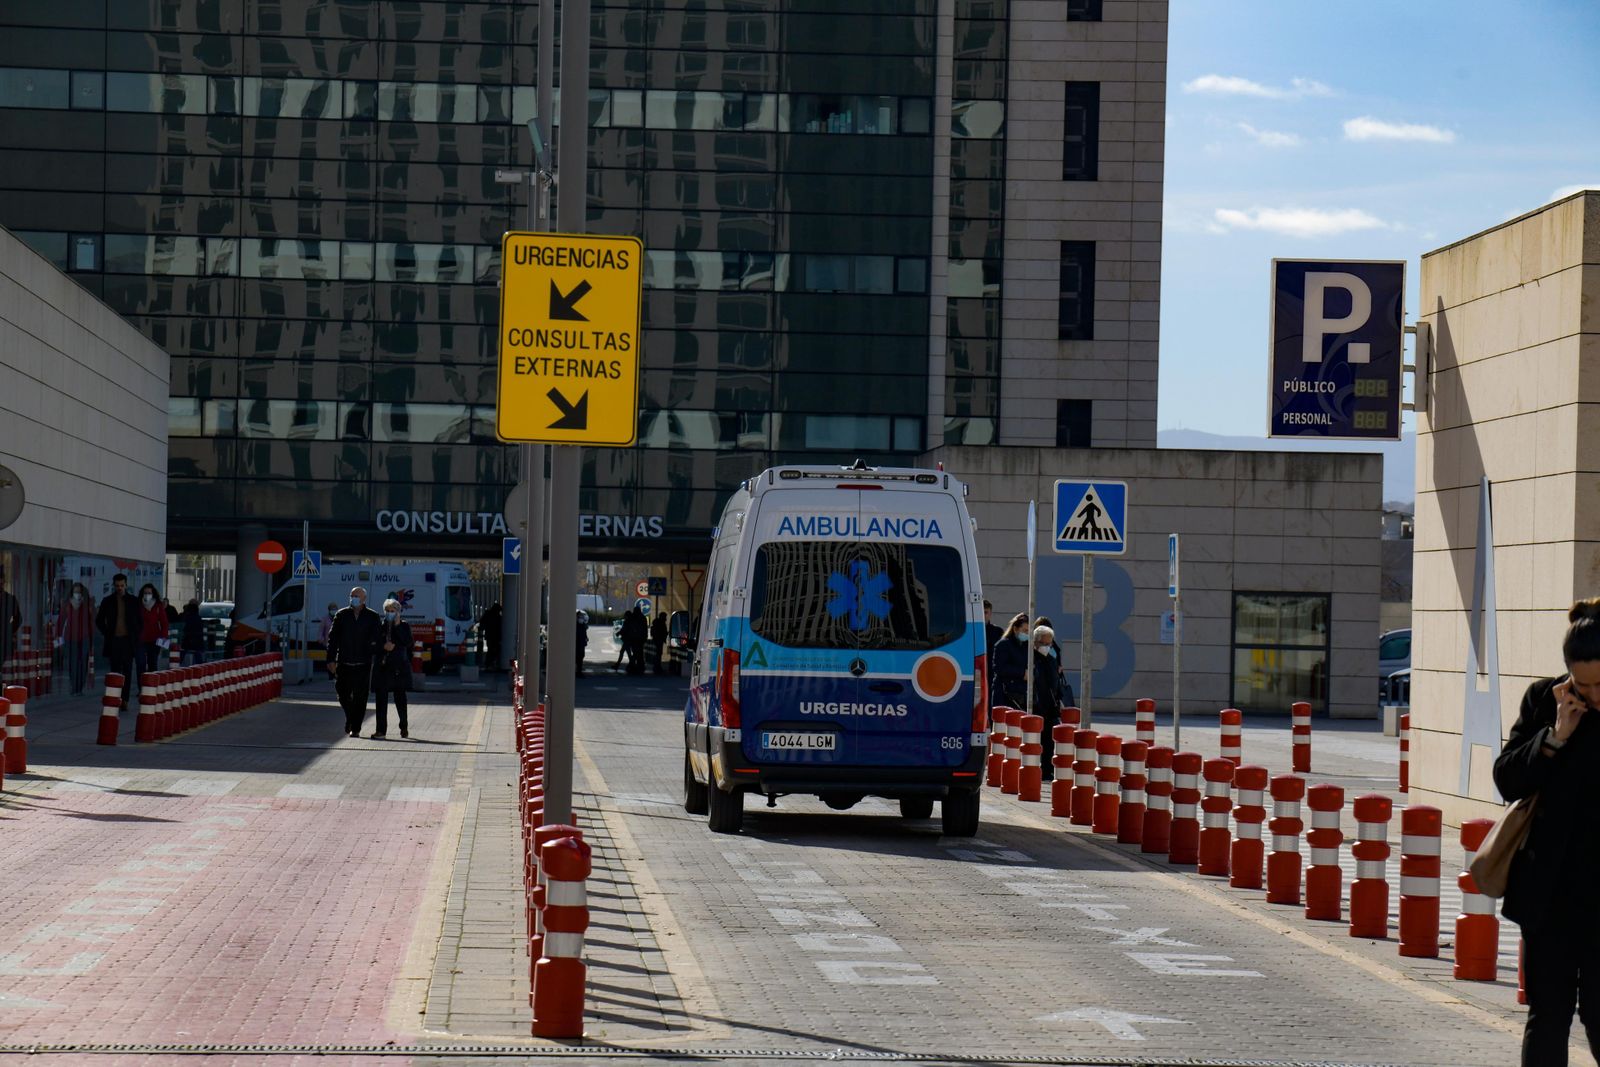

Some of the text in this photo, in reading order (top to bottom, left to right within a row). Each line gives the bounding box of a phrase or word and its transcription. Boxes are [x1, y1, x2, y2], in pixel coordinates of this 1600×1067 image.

[514, 244, 630, 270] URGENCIAS
[508, 327, 631, 352] CONSULTAS
[514, 356, 622, 380] EXTERNAS
[1283, 377, 1336, 393] PÚBLICO
[1282, 412, 1333, 425] PERSONAL
[376, 510, 512, 534] CONSULTA
[777, 516, 943, 539] AMBULANCIA
[341, 572, 401, 582] UVI MÓVIL
[799, 702, 908, 717] URGENCIAS
[770, 735, 833, 749] 4044 LGM
[941, 736, 964, 750] 606
